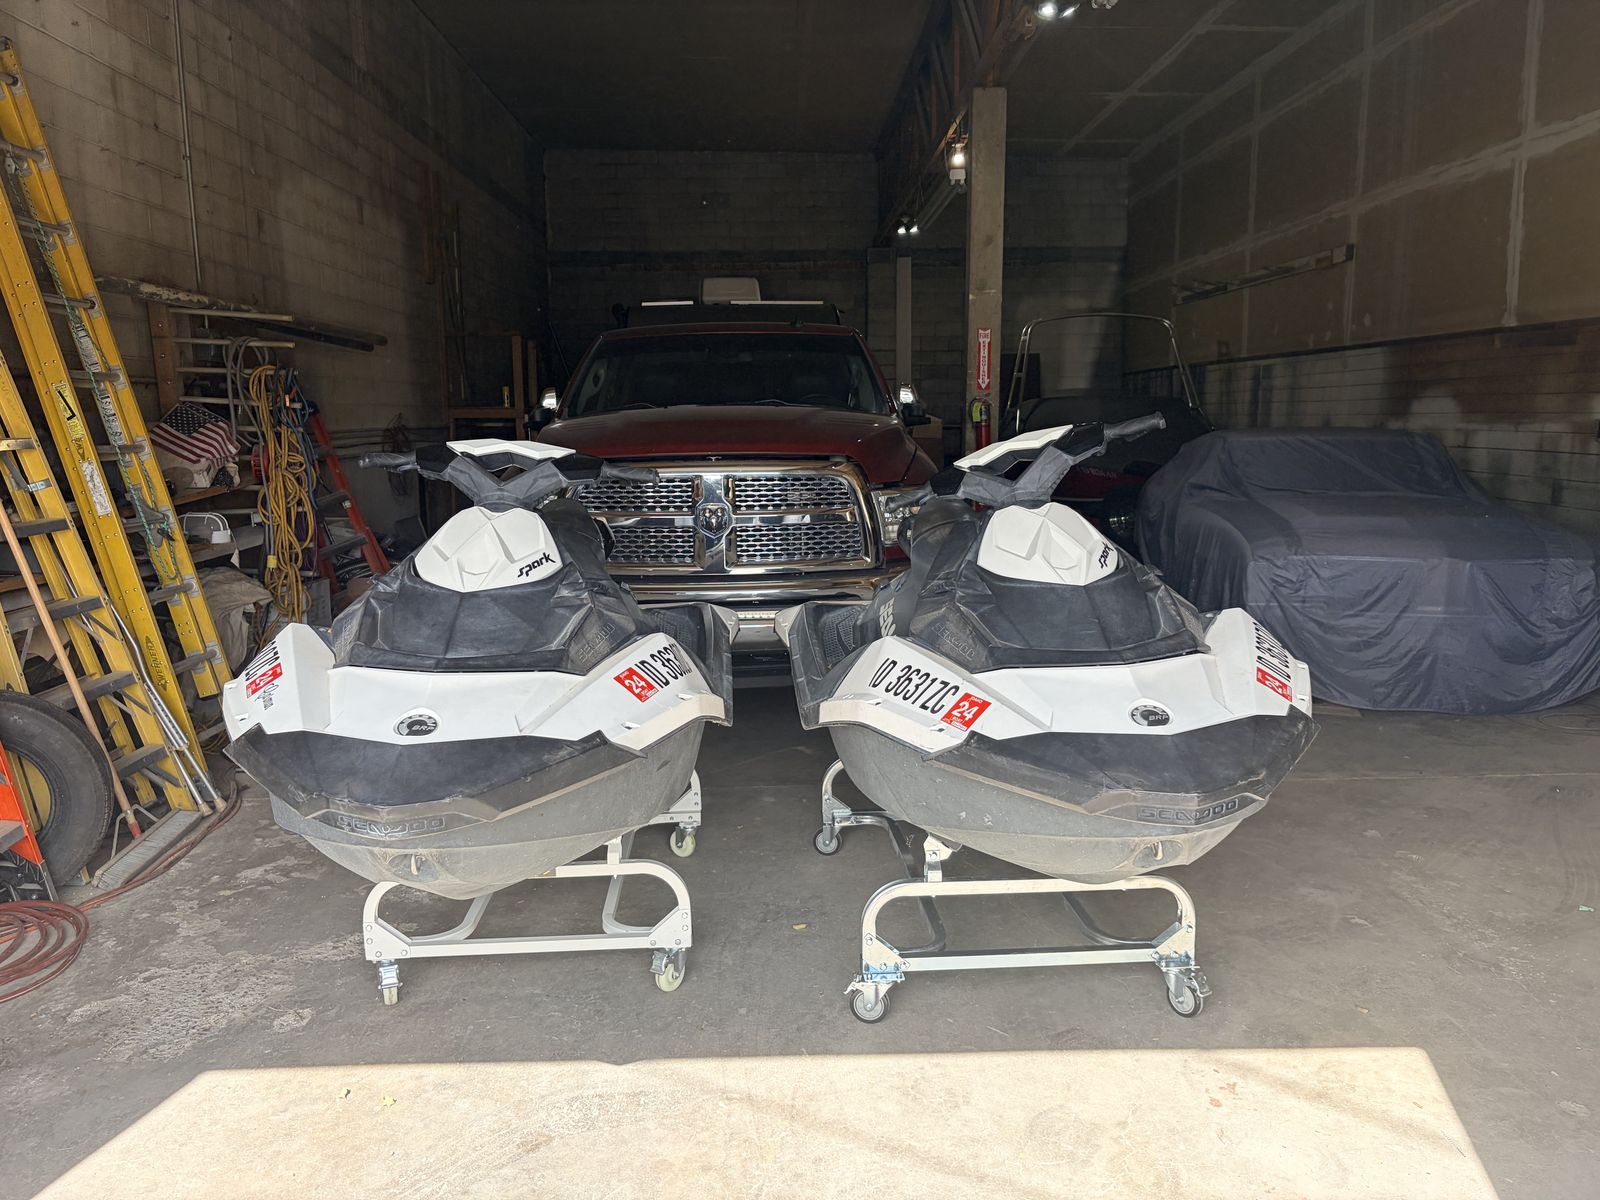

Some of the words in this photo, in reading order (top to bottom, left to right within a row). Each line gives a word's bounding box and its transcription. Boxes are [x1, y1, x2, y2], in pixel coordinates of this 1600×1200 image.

[517, 552, 556, 578] spark
[634, 660, 671, 689] ID
[868, 658, 898, 688] ID
[1256, 655, 1292, 682] ID
[624, 674, 648, 694] 24
[951, 701, 979, 721] 24
